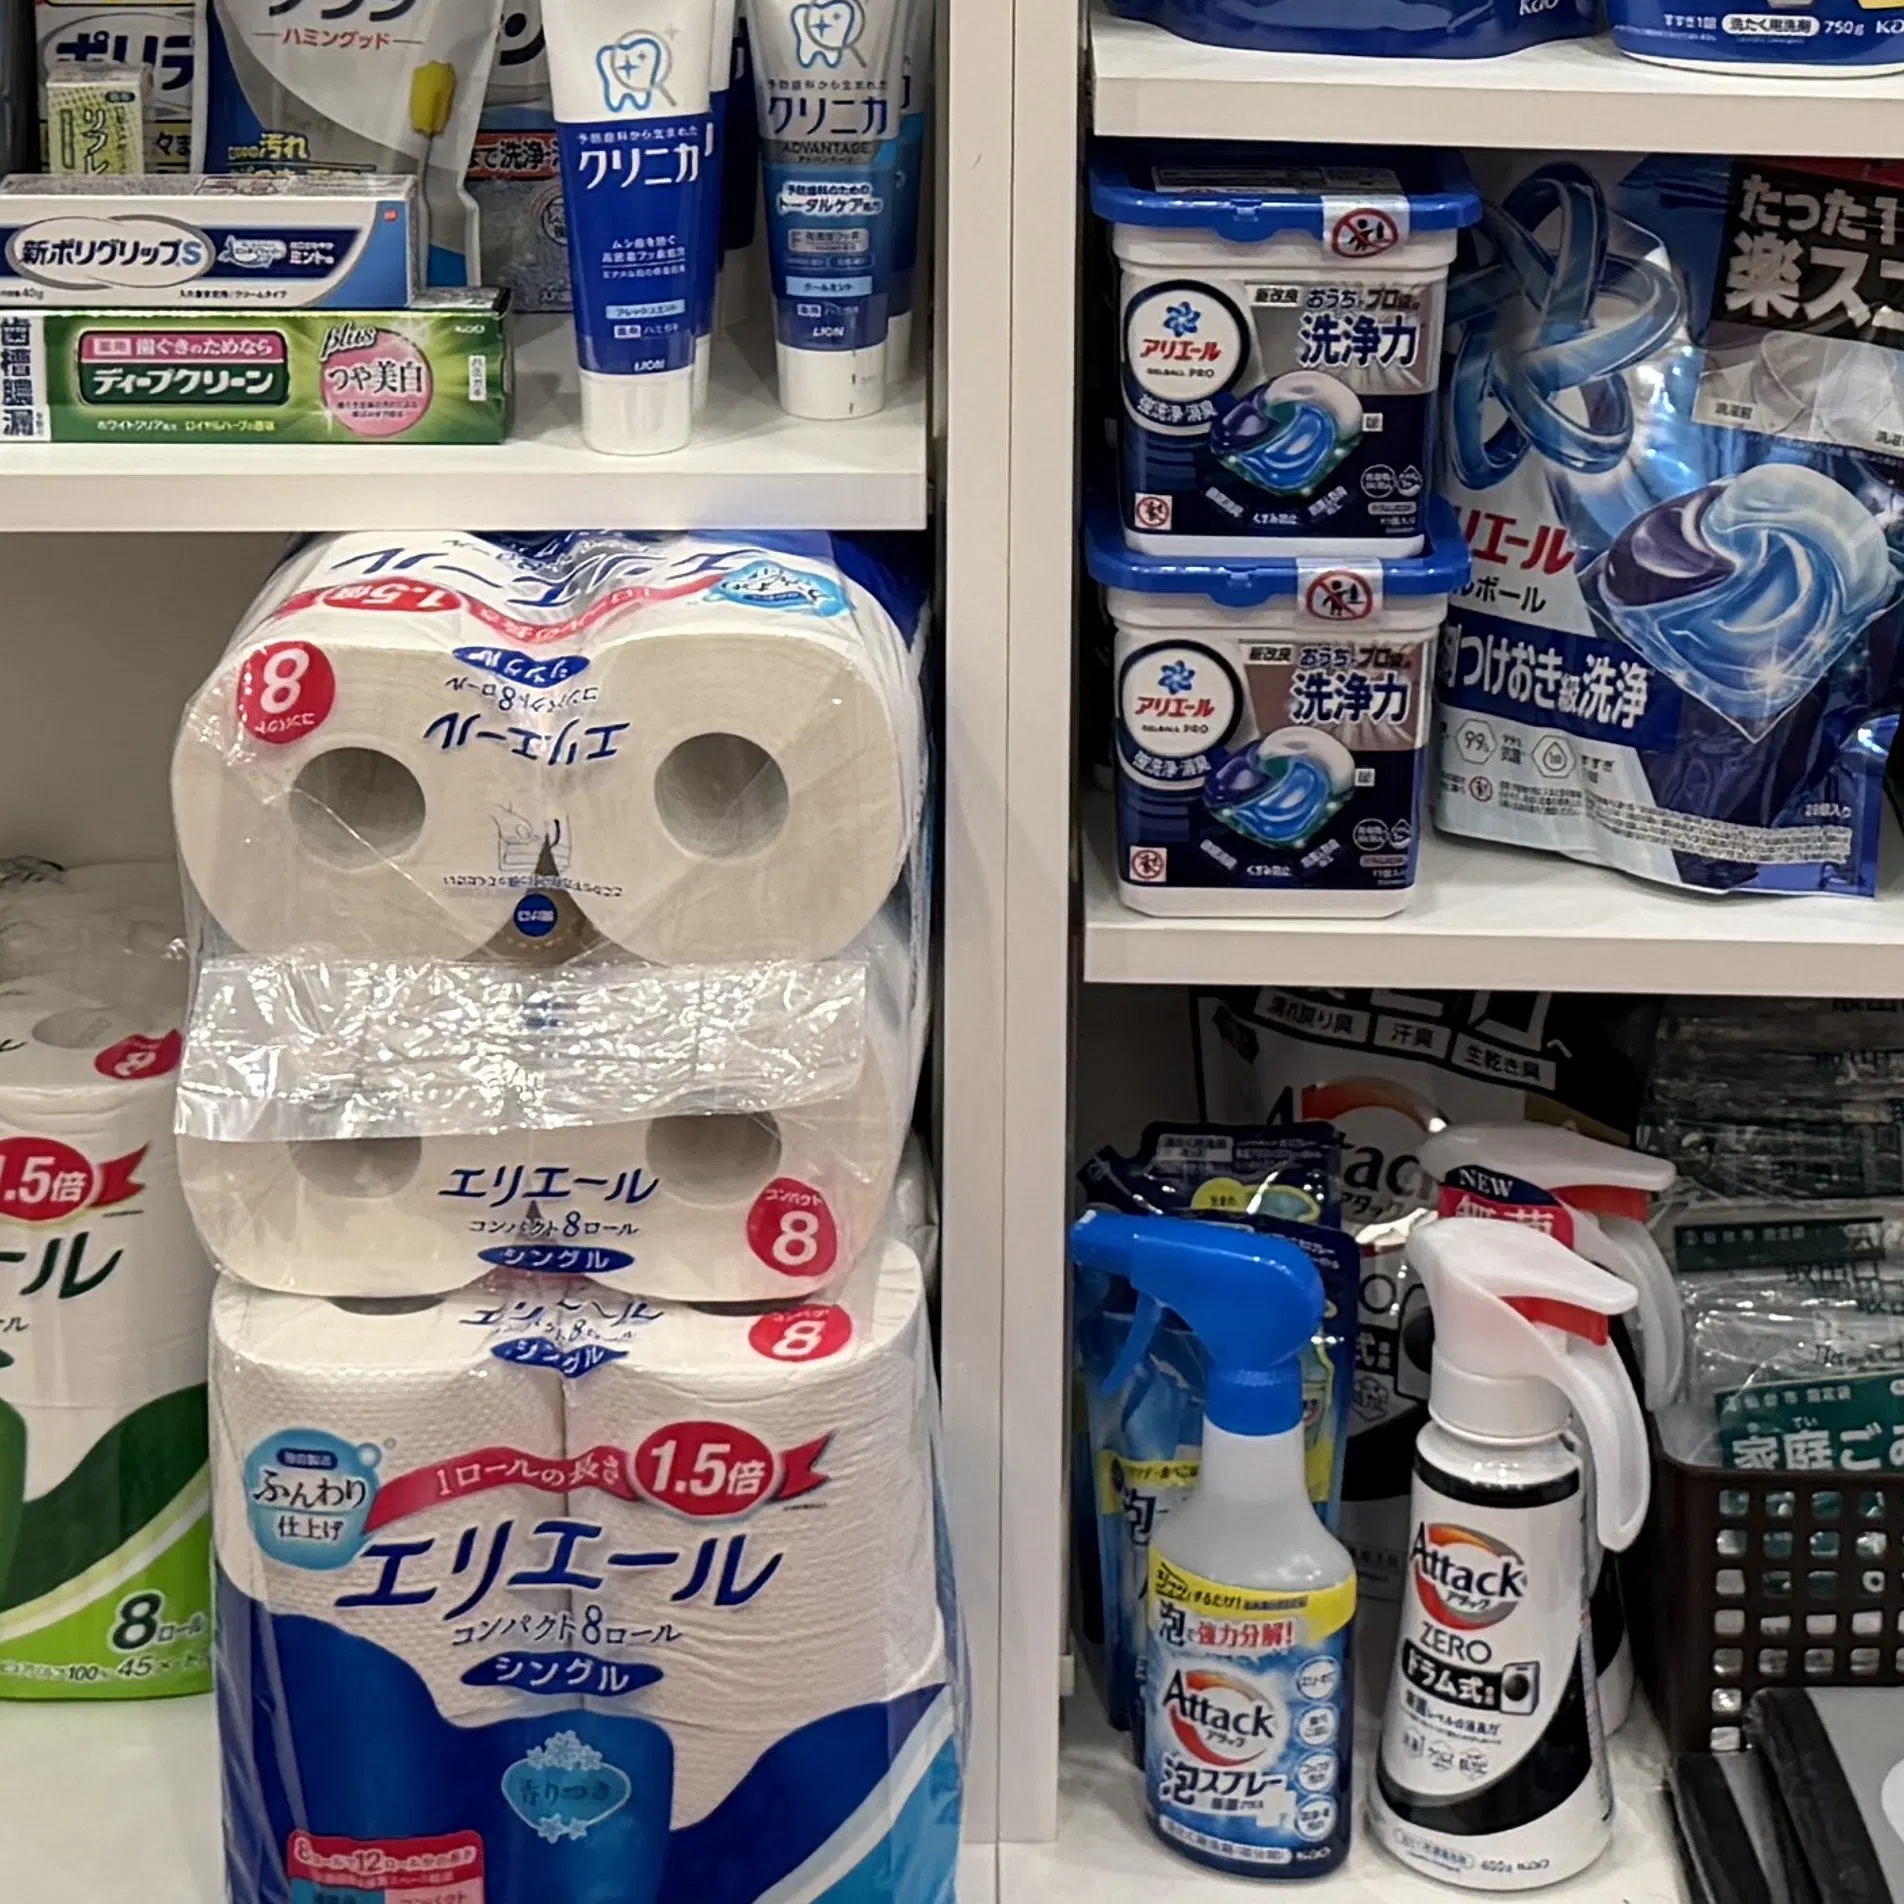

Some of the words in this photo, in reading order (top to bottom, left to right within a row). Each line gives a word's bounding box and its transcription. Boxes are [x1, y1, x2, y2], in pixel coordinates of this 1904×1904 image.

[767, 98, 887, 136] クリニカ
[578, 143, 699, 189] クリニカ
[1141, 339, 1222, 361] アリエール
[1298, 316, 1418, 366] 洗浄力
[90, 365, 274, 396] ディープクリーン
[326, 365, 423, 396] つや美白
[1136, 697, 1215, 717] アリエール
[1291, 674, 1409, 723] 洗浄力
[439, 1165, 658, 1205] エリエール
[502, 1247, 609, 1270] シングル
[649, 1441, 765, 1496] 1.5倍
[253, 1474, 366, 1508] ふんわり
[277, 1515, 345, 1541] 仕上げ
[336, 1518, 784, 1621] エリエール
[1411, 1525, 1526, 1600] Attack
[453, 1605, 681, 1647] コンパクト8ロール
[1420, 1623, 1494, 1665] ZERO
[494, 1656, 630, 1692] シングル
[1162, 1672, 1276, 1736] Attack
